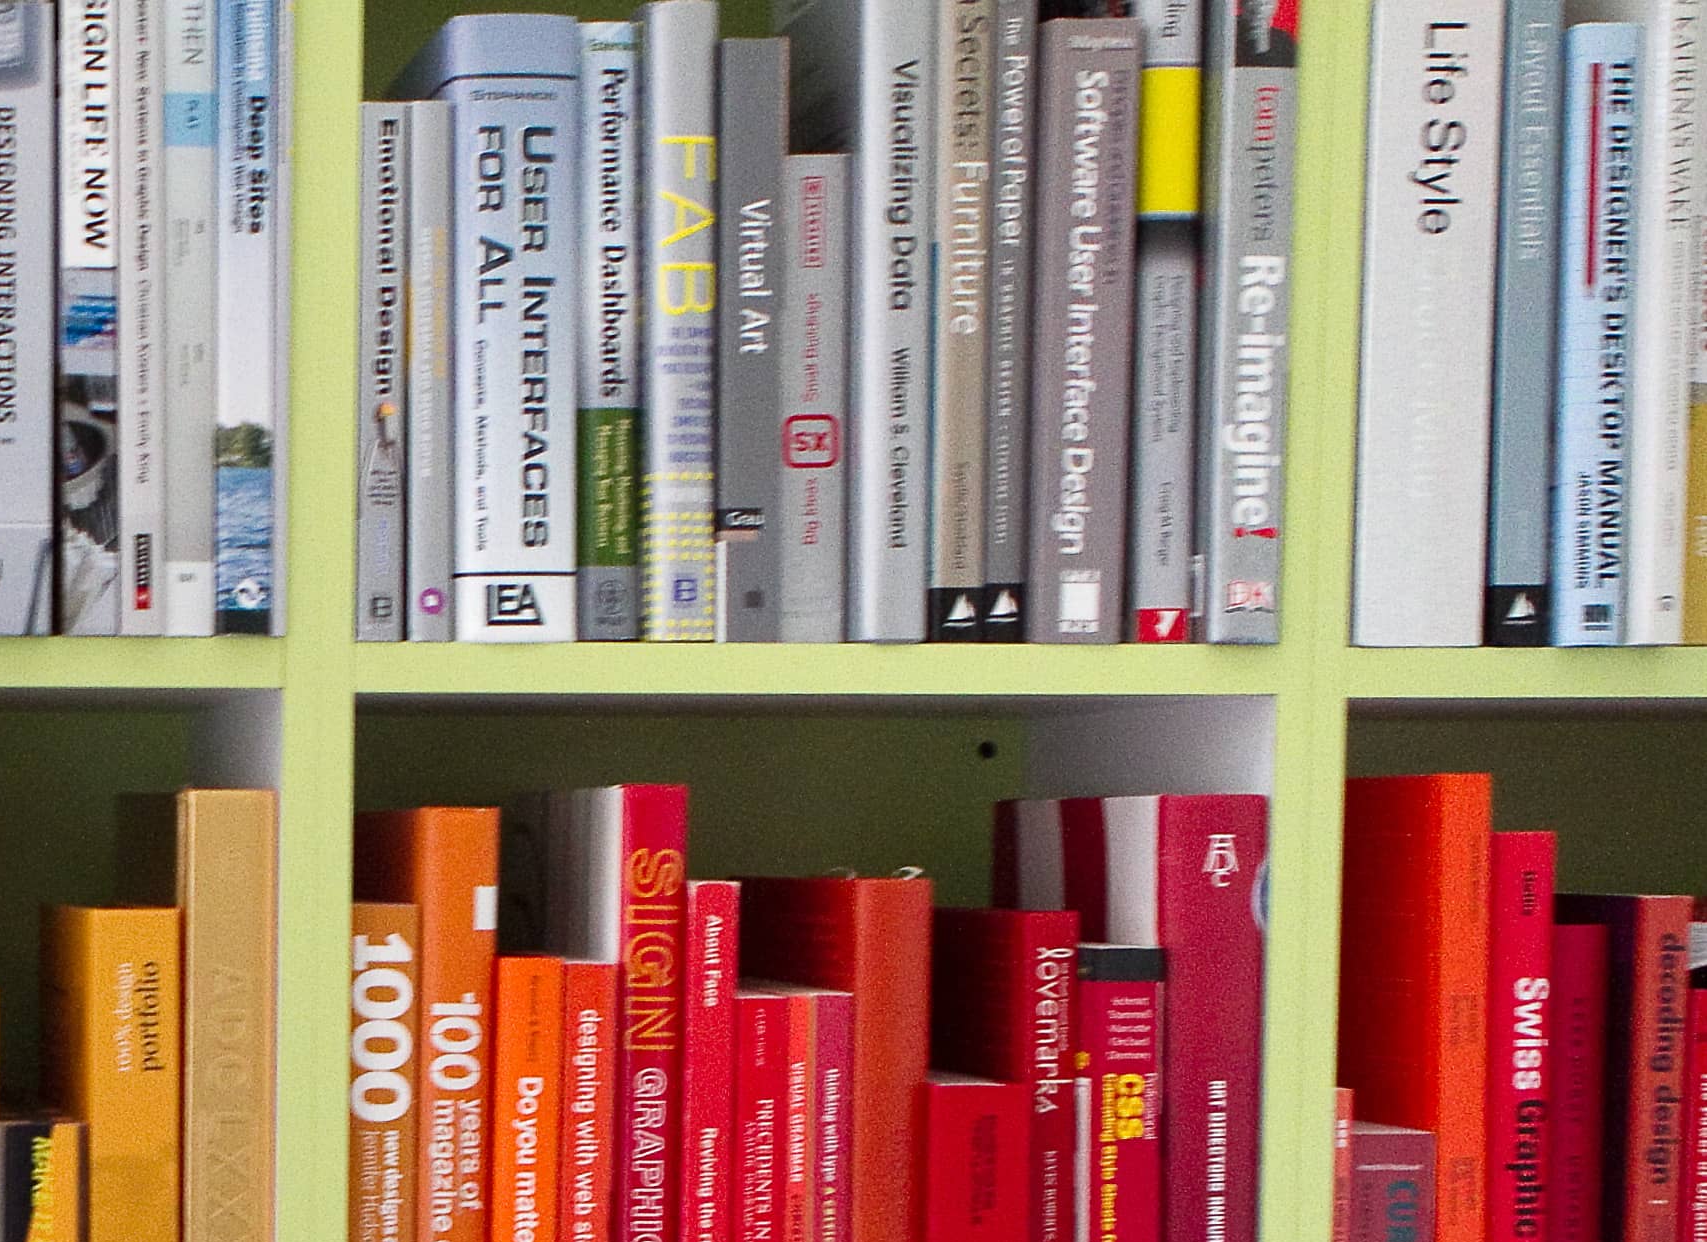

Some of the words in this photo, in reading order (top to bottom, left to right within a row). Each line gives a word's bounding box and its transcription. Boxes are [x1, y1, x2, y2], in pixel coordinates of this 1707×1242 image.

[1003, 54, 1028, 137] Power
[1423, 21, 1470, 104] Life
[1611, 59, 1633, 115] THE
[83, 82, 109, 151] LIFE
[599, 68, 628, 233] Performance
[887, 60, 919, 225] Visualizing
[1002, 139, 1026, 163] of
[1074, 70, 1106, 218] Software
[84, 168, 109, 250] NOW
[997, 168, 1027, 247] Paper
[1408, 119, 1467, 235] Style
[1604, 125, 1631, 302] DESIGNER'S
[659, 134, 718, 316] FAB
[739, 199, 772, 298] Virtual
[949, 161, 987, 335] Furniture
[1068, 224, 1103, 295] User
[891, 236, 915, 310] Data
[602, 245, 628, 398] Dashboards
[739, 308, 769, 354] Art
[1062, 303, 1103, 439] Interface
[1600, 312, 1625, 449] DESKTOP
[1052, 447, 1095, 554] Design
[1598, 460, 1623, 583] MANUAL
[625, 849, 680, 1051] SIGN
[352, 933, 411, 1121] 1000
[430, 994, 479, 1091] 100
[572, 1010, 602, 1112] designing
[1513, 977, 1550, 1089] Swiss
[457, 1100, 481, 1174] years
[519, 1076, 543, 1116] Do
[1118, 1073, 1143, 1138] CSS
[384, 1130, 399, 1165] new
[425, 1098, 455, 1234] magazine
[514, 1119, 539, 1165] you
[574, 1119, 598, 1165] with
[694, 1128, 718, 1196] Reviving
[822, 1125, 839, 1153] with
[1511, 1099, 1545, 1236] Graphic
[380, 1168, 402, 1236] designs
[459, 1181, 481, 1210] of
[574, 1172, 596, 1214] web
